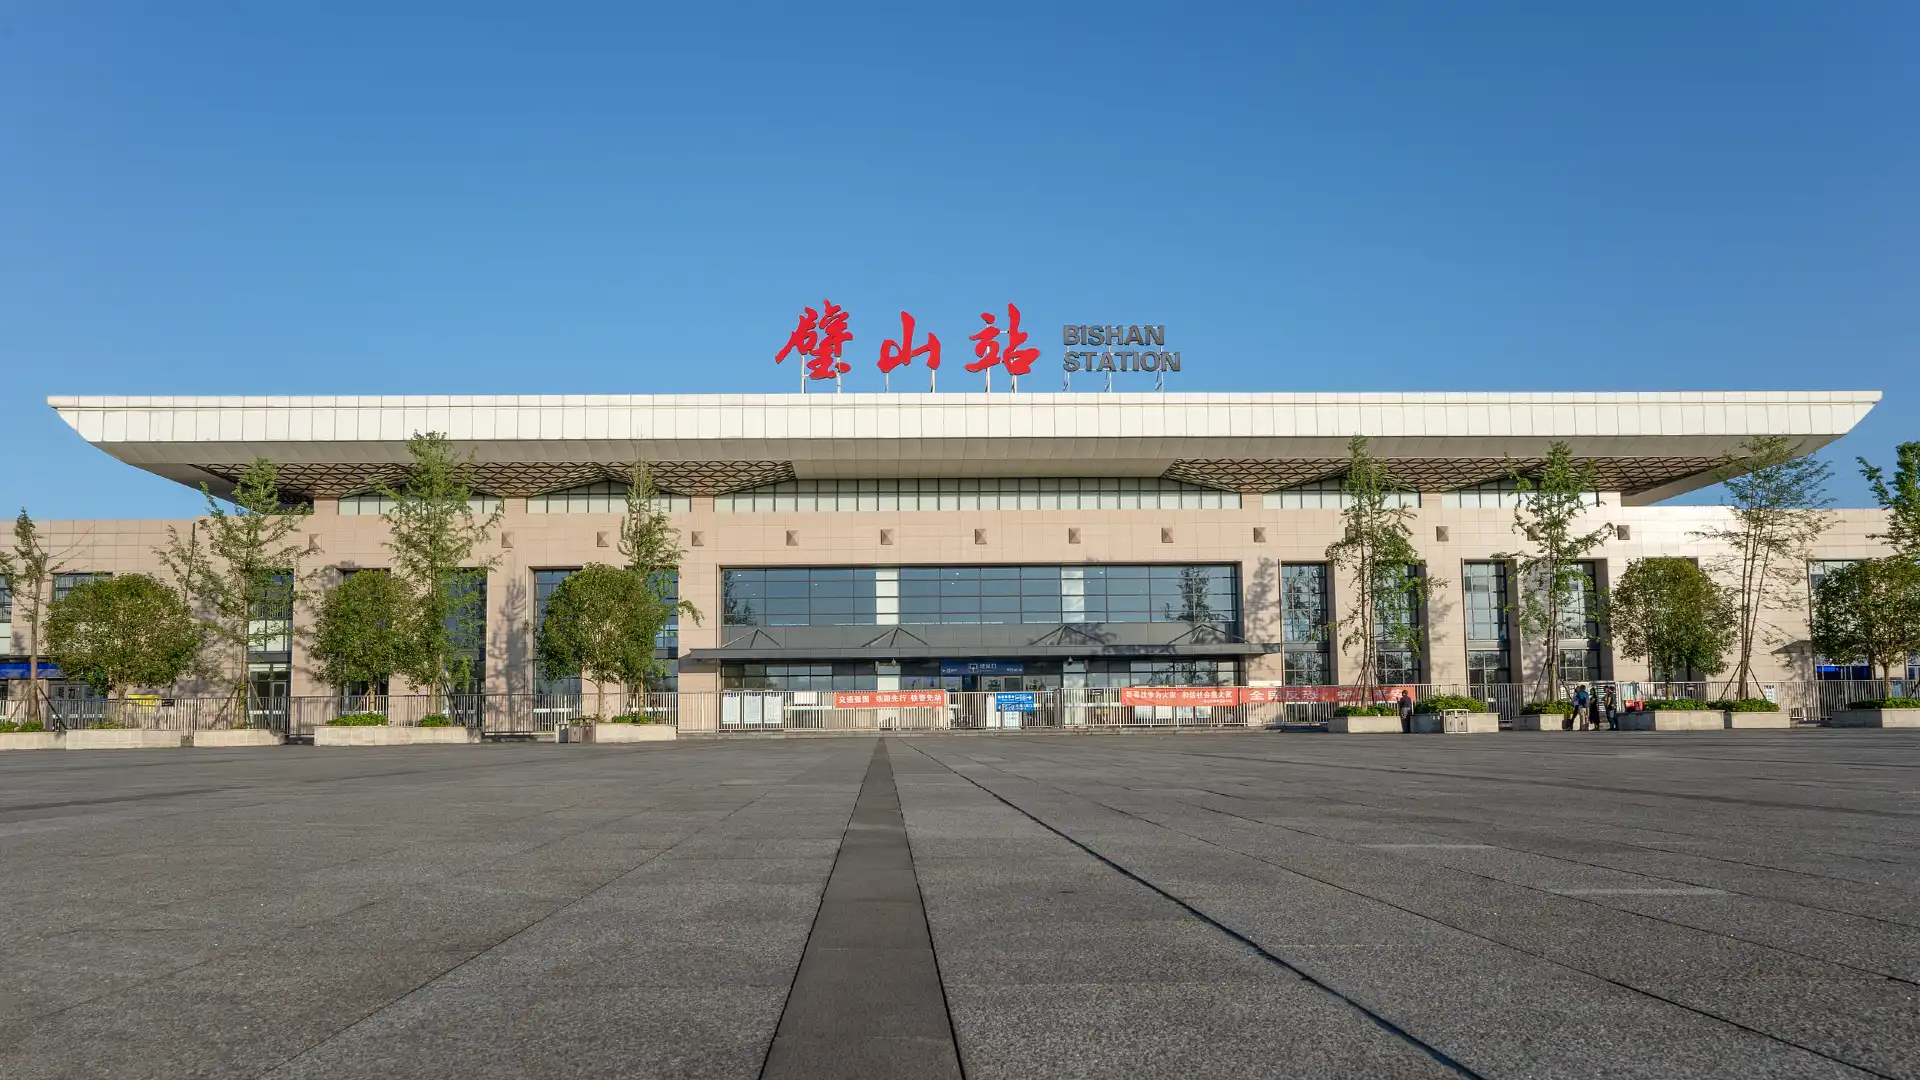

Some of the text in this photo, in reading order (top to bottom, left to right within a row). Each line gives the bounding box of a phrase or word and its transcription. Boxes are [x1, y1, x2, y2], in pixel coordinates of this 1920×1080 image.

[775, 299, 1041, 380] 璧山站
[1063, 325, 1165, 346] BISHAN
[1063, 350, 1181, 373] STATION
[838, 695, 870, 704] 交通强国
